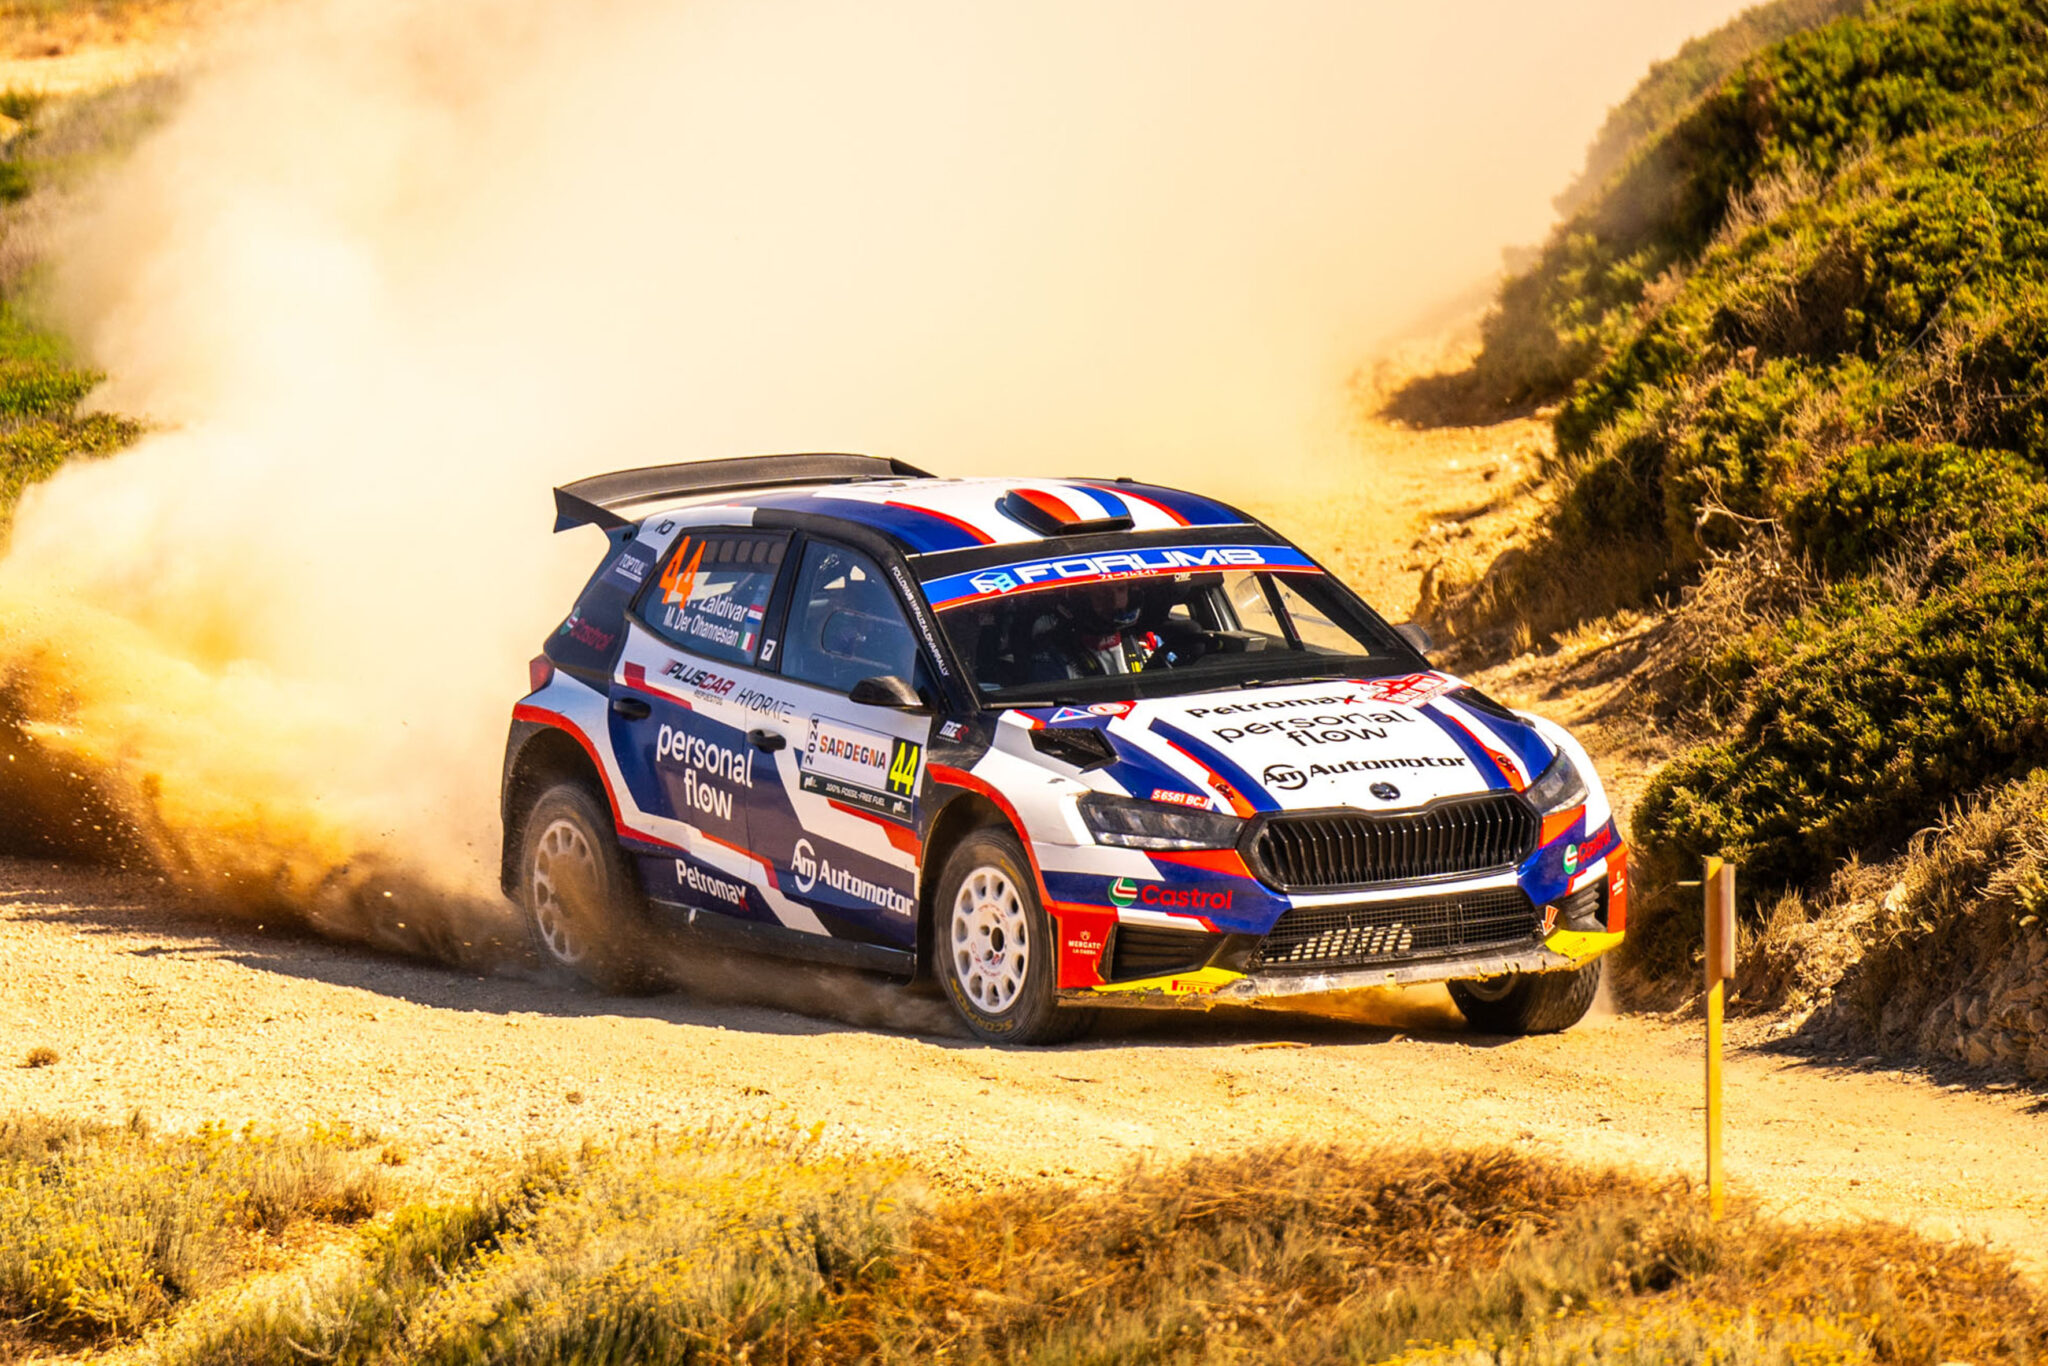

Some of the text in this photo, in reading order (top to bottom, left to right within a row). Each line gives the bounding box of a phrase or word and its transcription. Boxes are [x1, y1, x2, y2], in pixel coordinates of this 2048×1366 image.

[659, 535, 707, 610] 44
[1013, 549, 1265, 584] FORUM8
[673, 609, 693, 633] Der
[698, 594, 748, 622] Zaldivar
[764, 643, 773, 656] 7
[665, 661, 736, 696] PLUSCAR
[1185, 693, 1365, 718] Petromax
[805, 718, 820, 766] 2024
[1211, 709, 1417, 744] personal
[1286, 726, 1389, 747] flow
[656, 723, 755, 788] personal
[819, 735, 887, 770] SARDEGNA
[889, 742, 919, 795] 44
[1309, 755, 1466, 778] Automotor
[684, 768, 733, 821] flow
[675, 859, 750, 912] Petromax
[818, 859, 915, 917] Automotor
[1141, 885, 1234, 911] Castrol
